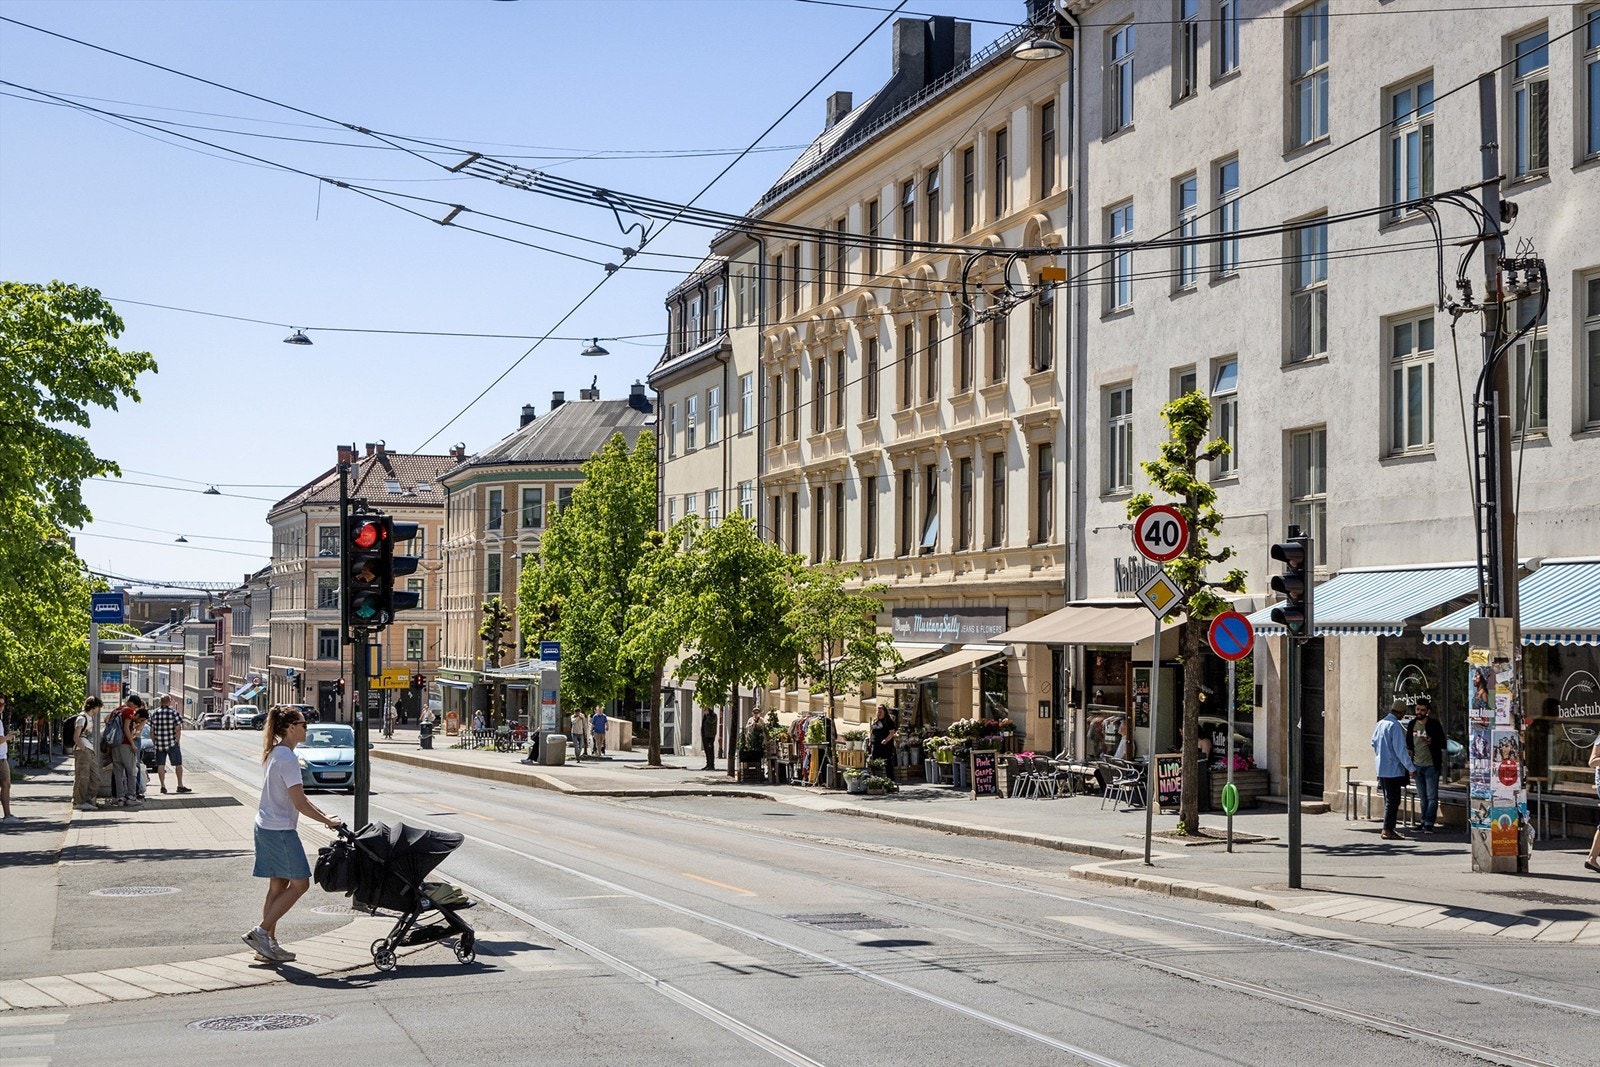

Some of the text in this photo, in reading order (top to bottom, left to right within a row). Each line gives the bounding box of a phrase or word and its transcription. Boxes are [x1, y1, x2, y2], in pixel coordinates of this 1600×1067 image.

[1144, 520, 1178, 546] 40
[961, 624, 975, 633] JEANS
[980, 625, 1002, 634] FLOWERS
